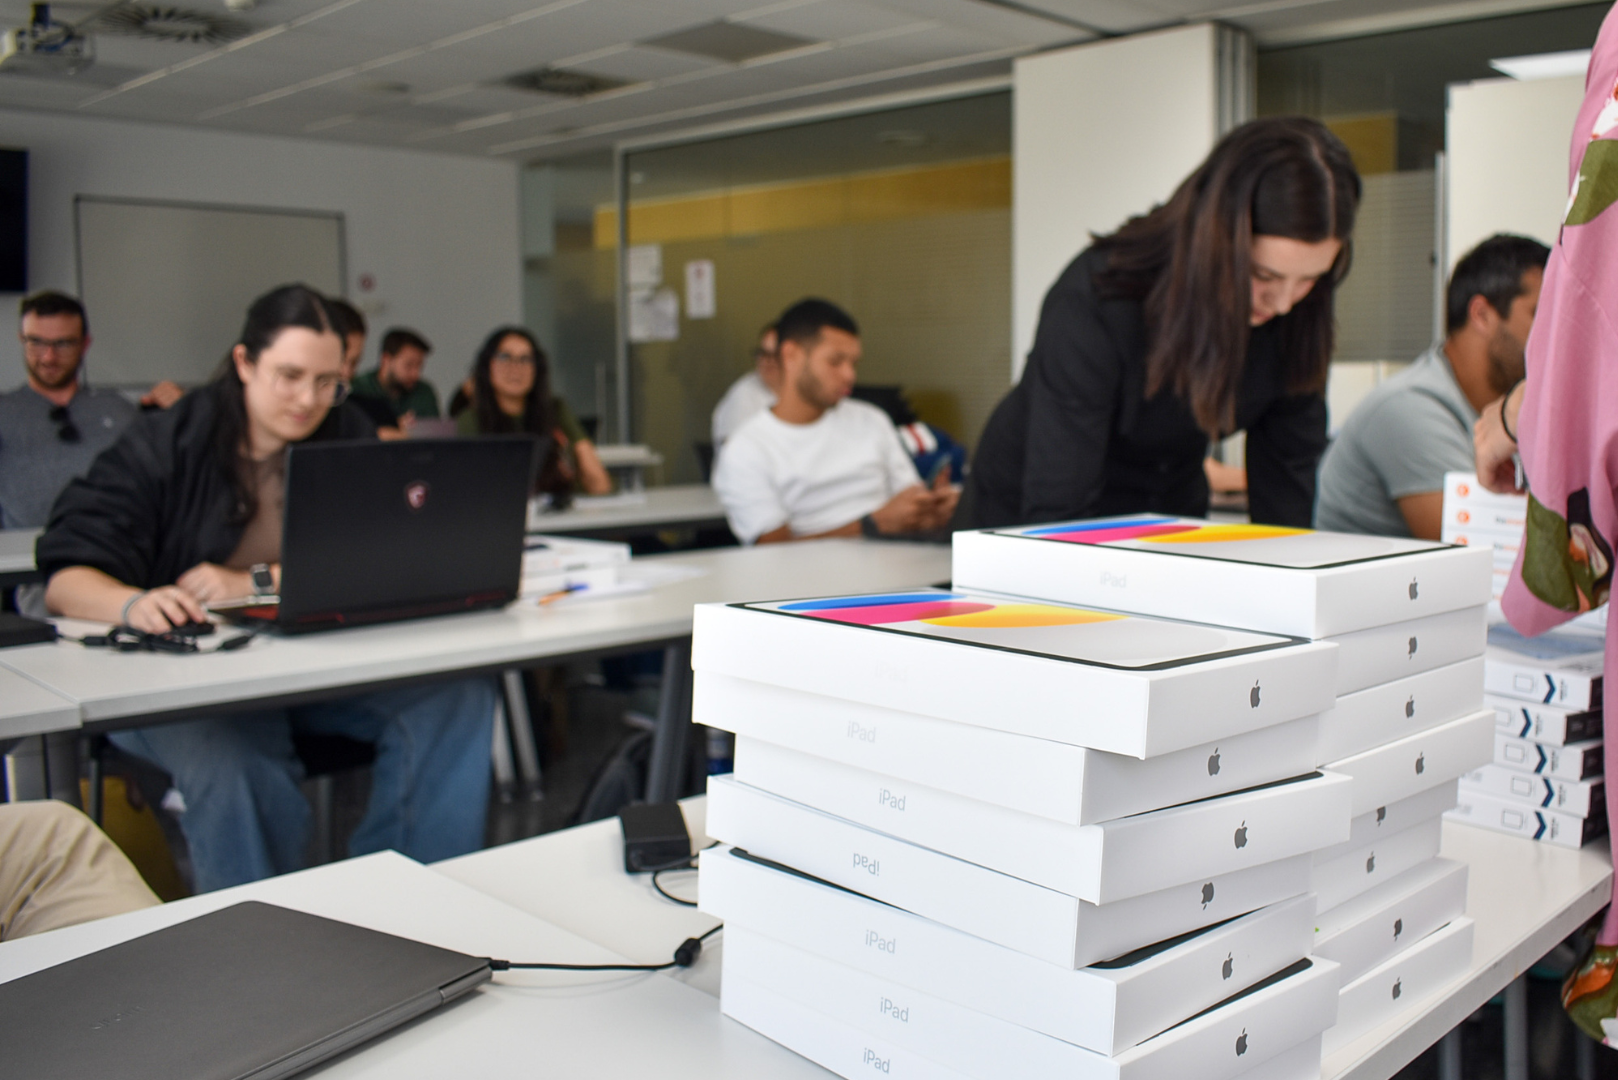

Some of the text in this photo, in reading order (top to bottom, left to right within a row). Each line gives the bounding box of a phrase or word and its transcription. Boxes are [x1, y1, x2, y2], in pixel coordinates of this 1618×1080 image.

[1100, 571, 1127, 589] iPad
[847, 721, 876, 743] iPad
[878, 787, 906, 812] iPad
[852, 852, 880, 877] iPad
[865, 929, 896, 954] iPad
[879, 996, 909, 1023] iPad
[863, 1047, 891, 1075] iPad
